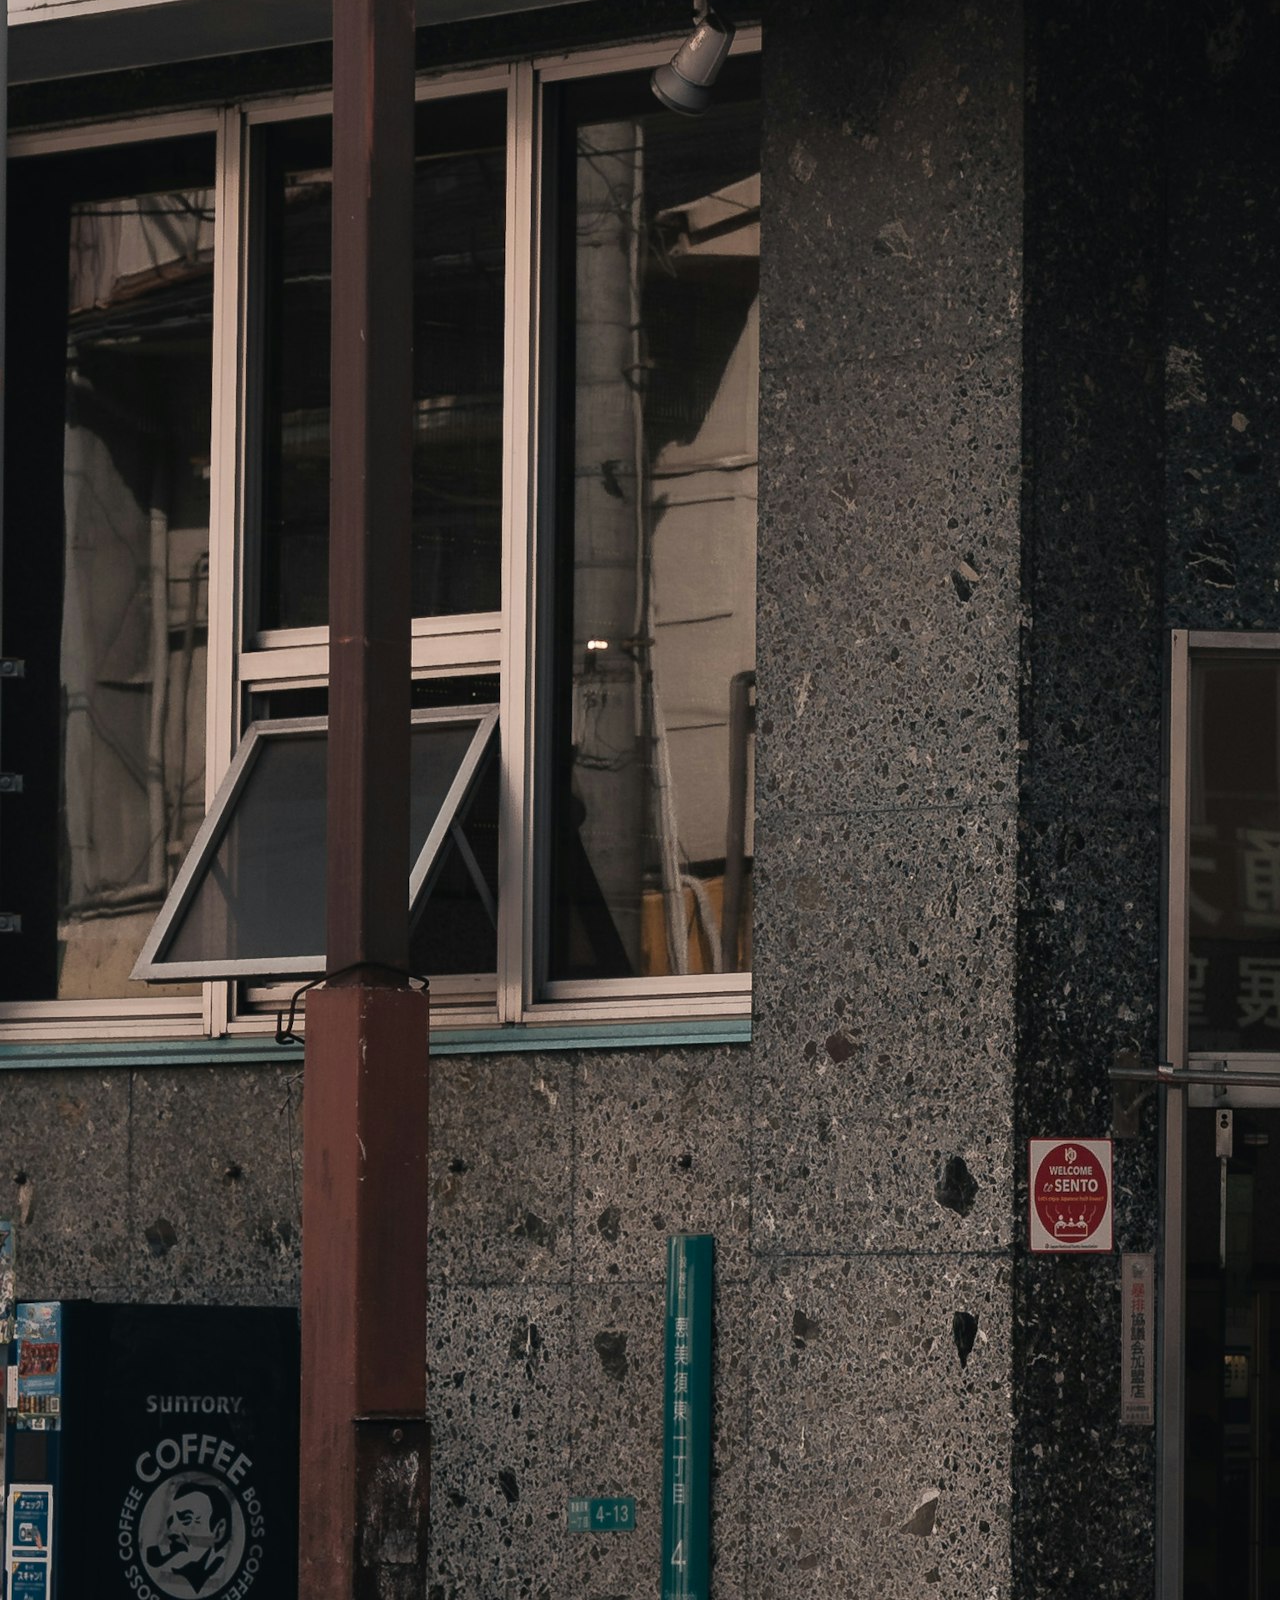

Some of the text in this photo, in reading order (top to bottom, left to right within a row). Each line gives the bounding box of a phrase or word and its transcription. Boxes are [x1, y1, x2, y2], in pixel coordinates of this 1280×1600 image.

[1043, 1179, 1099, 1193] to SENTO
[1049, 1165, 1093, 1176] WELCOME
[135, 1433, 254, 1486] COFFEE
[117, 1485, 145, 1562] COFFEE
[241, 1485, 266, 1538] BOSS
[595, 1504, 629, 1523] 4-13
[670, 1539, 687, 1573] 4
